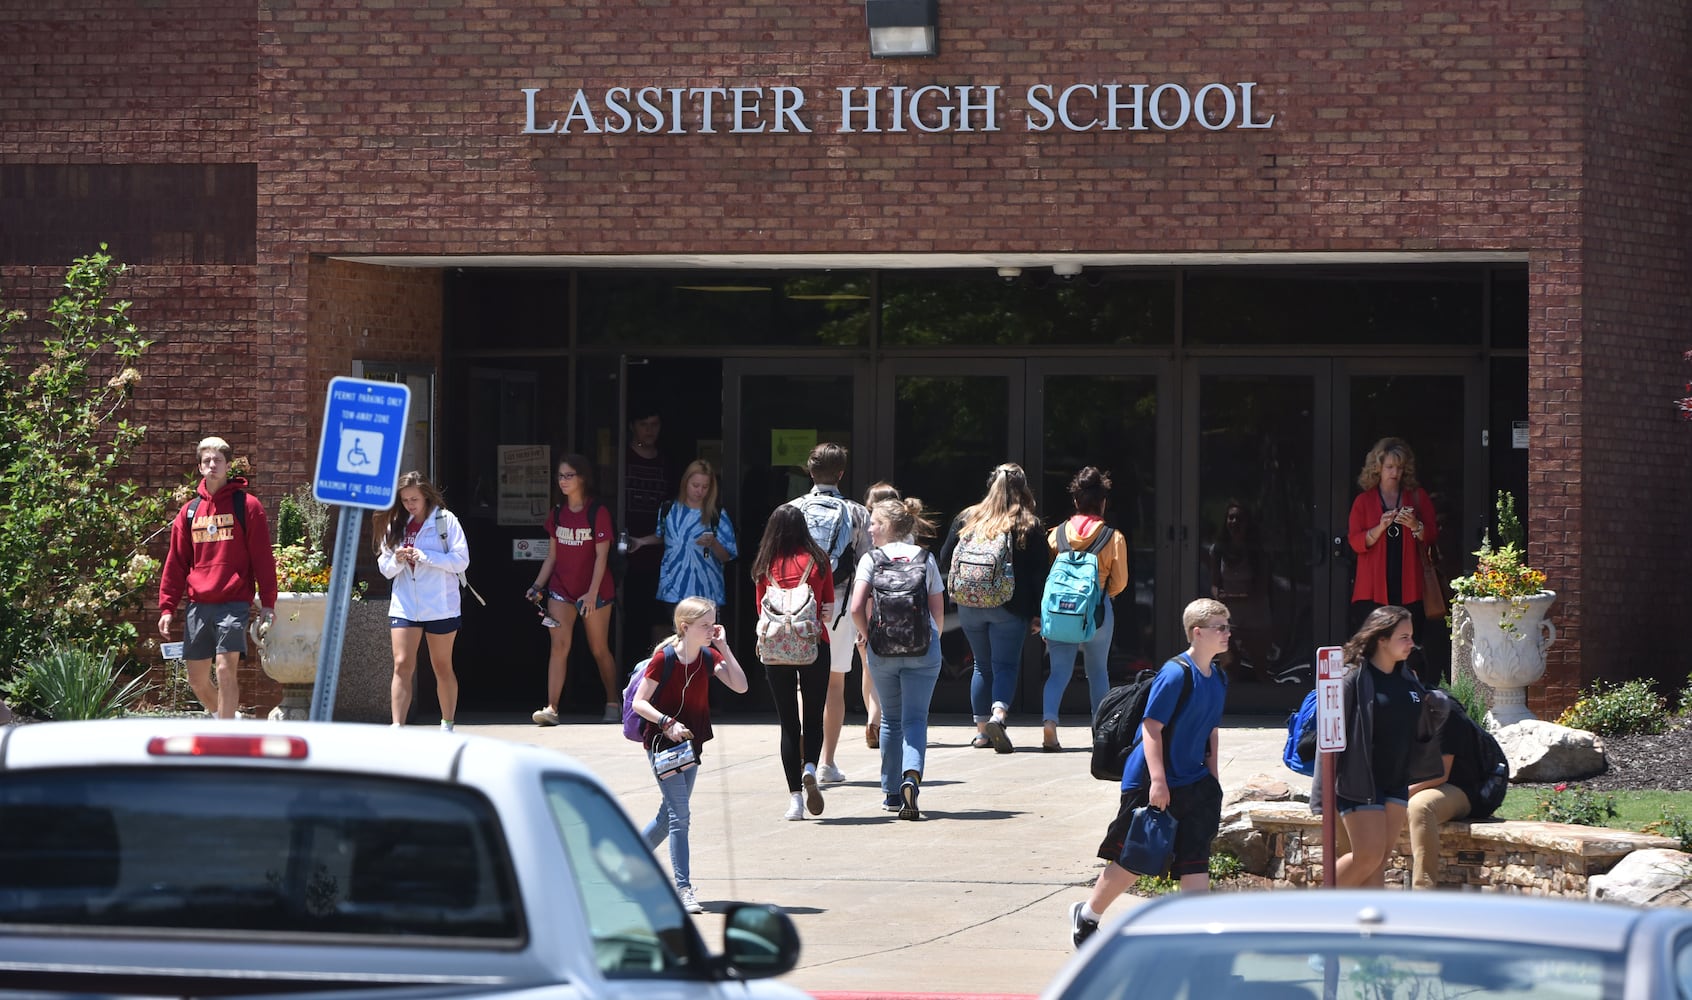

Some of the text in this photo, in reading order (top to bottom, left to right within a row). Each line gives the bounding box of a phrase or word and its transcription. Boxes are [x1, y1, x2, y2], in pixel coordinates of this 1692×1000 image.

[521, 82, 1275, 134] LASSITER HIGH SCHOOL
[335, 390, 403, 407] PERMIT PARKING ONLY
[374, 414, 390, 424] ZONE
[319, 480, 347, 490] MAXIMUM
[349, 483, 362, 493] FINE
[1320, 659, 1329, 675] NO
[1326, 685, 1339, 710] FIRE
[1325, 716, 1342, 742] LANE
